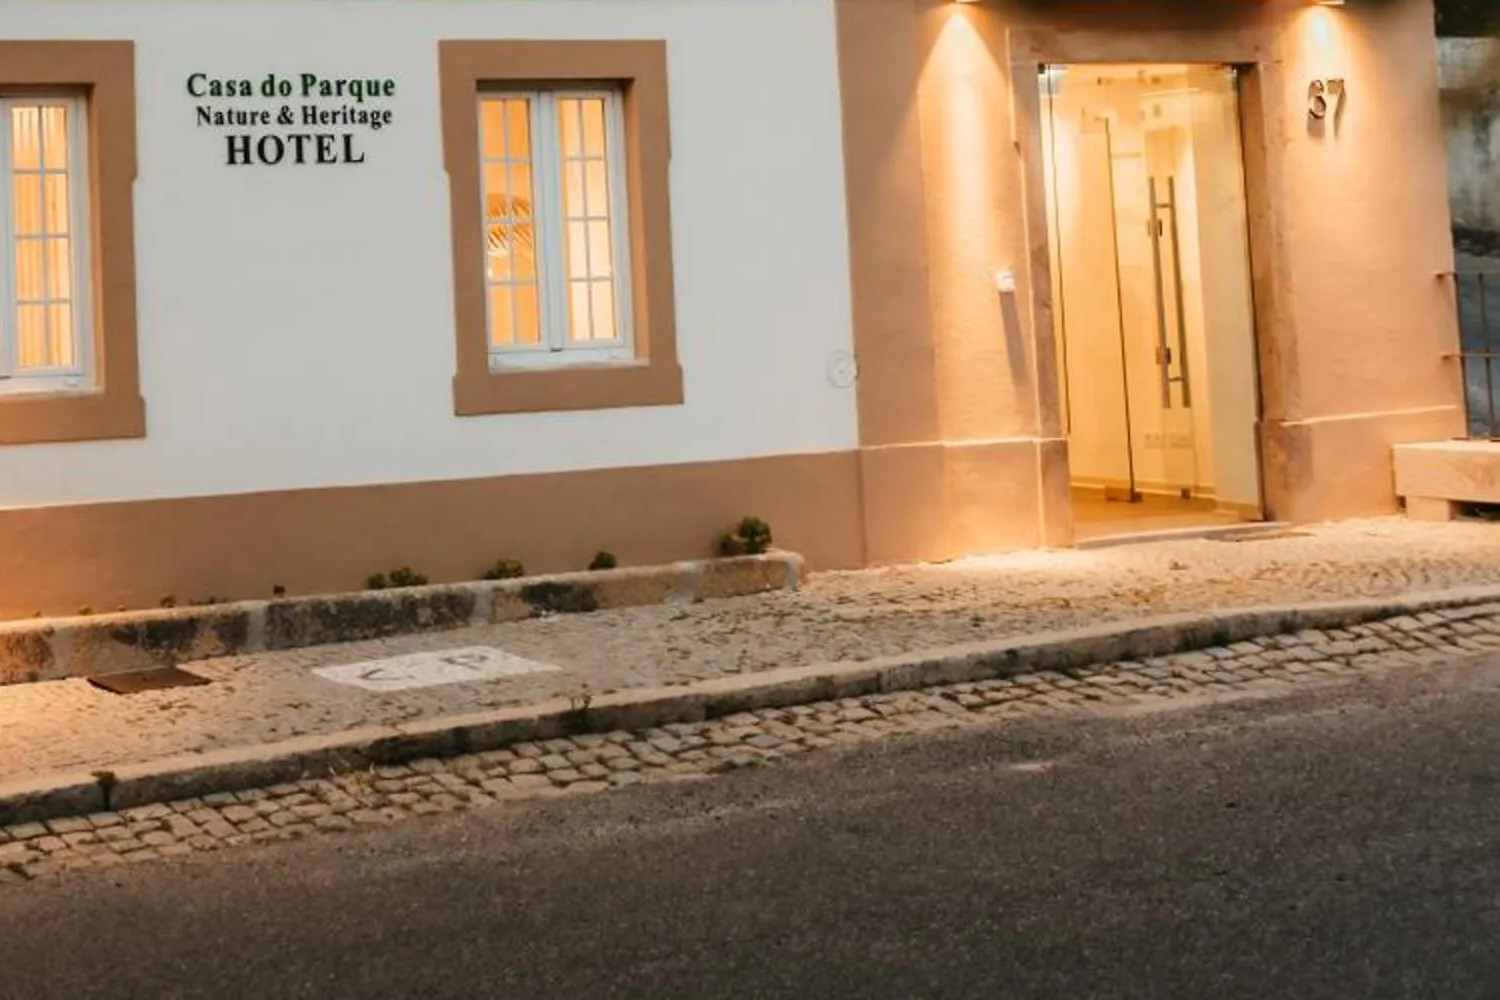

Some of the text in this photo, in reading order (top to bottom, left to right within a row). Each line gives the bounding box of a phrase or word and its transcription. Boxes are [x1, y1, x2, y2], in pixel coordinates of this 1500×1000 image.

[186, 73, 395, 102] Casa do Parque
[196, 105, 393, 130] Nature & Heritage
[225, 133, 365, 165] HOTEL
